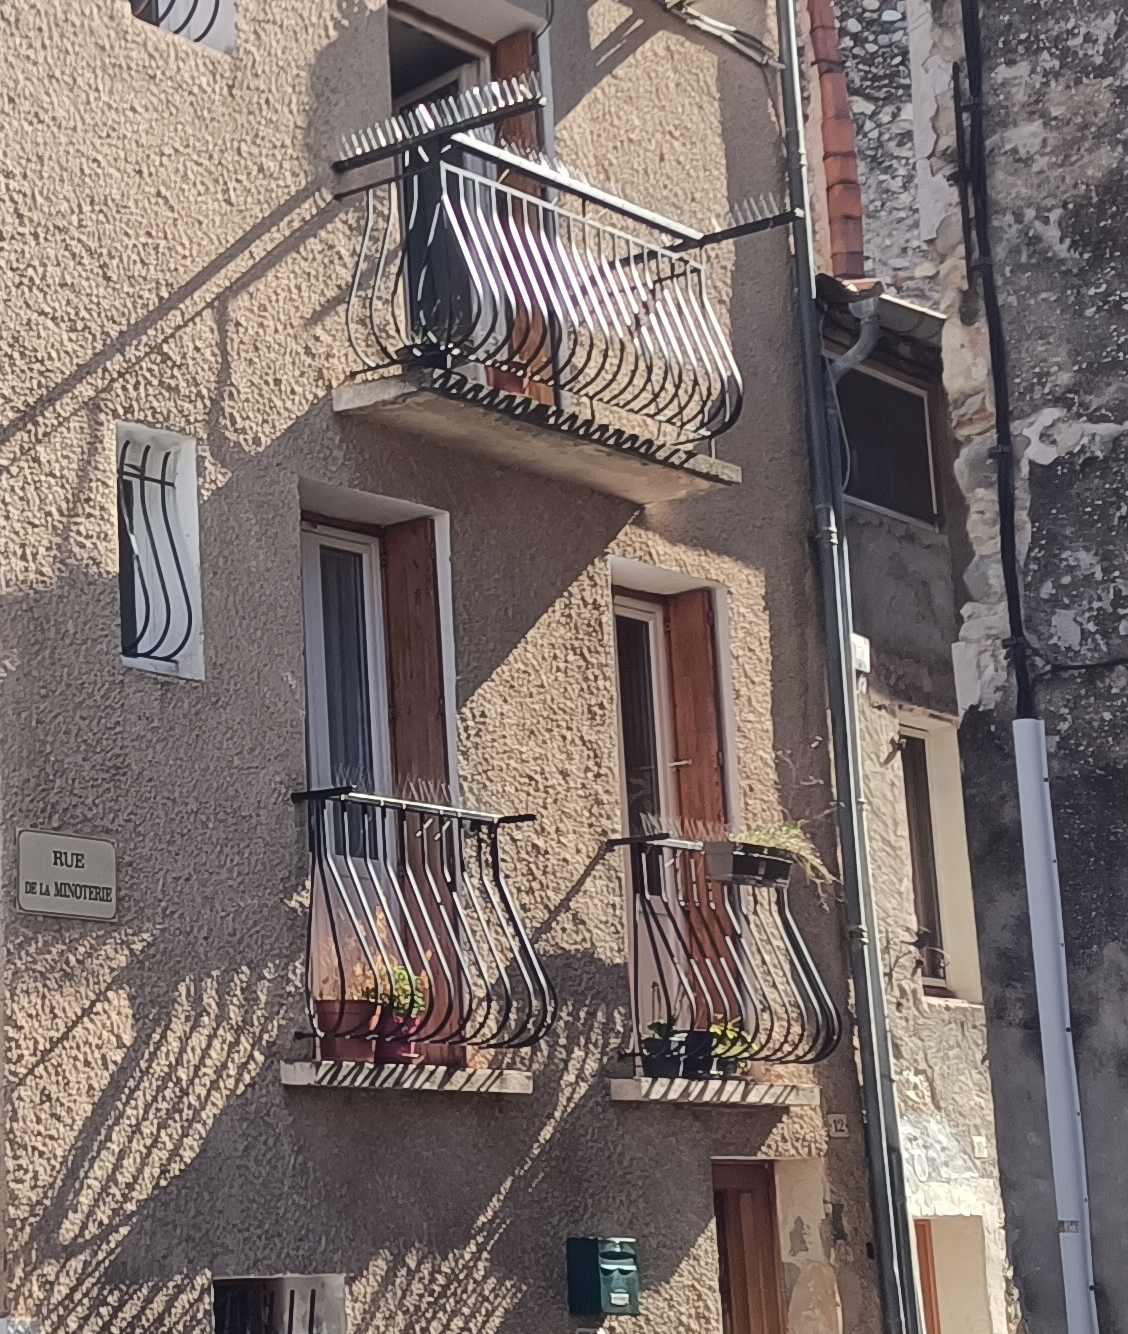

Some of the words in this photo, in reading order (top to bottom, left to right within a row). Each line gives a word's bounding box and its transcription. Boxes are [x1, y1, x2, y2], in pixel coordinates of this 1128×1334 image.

[52, 850, 85, 869] RUE
[24, 881, 37, 895] DE
[39, 882, 50, 897] LA
[53, 881, 113, 903] MINOTERIE
[832, 1118, 846, 1133] 12
